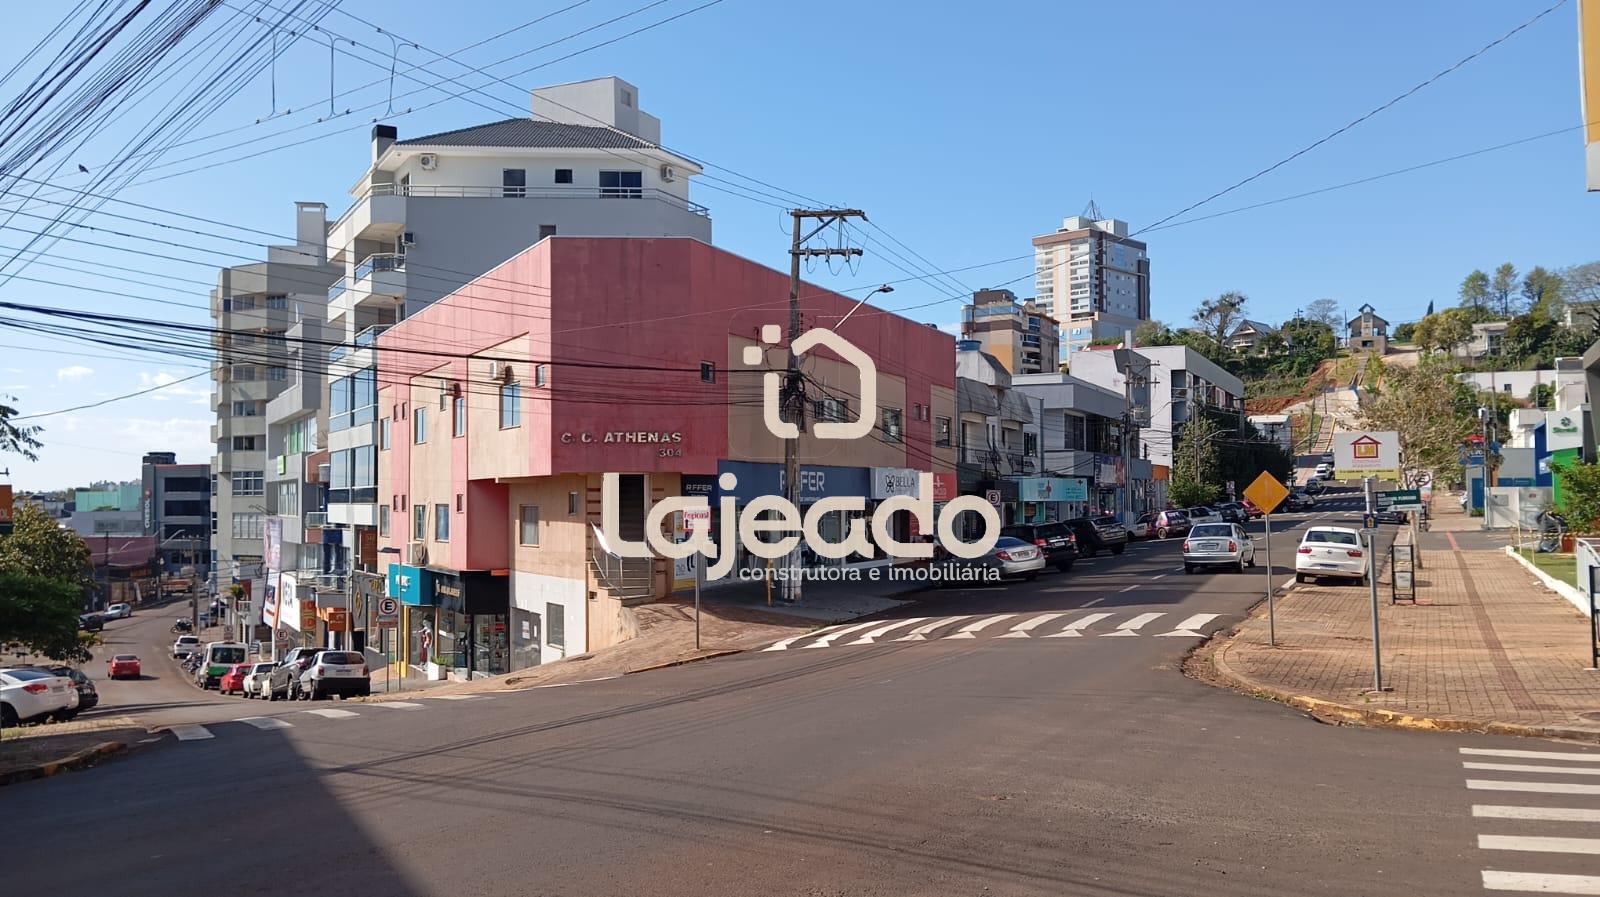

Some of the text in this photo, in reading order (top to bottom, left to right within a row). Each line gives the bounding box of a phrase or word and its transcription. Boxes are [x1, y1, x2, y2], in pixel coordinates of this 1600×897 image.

[604, 432, 682, 443] ATHENAS
[658, 448, 682, 457] 304
[895, 475, 915, 487] BELLA
[384, 601, 393, 611] E
